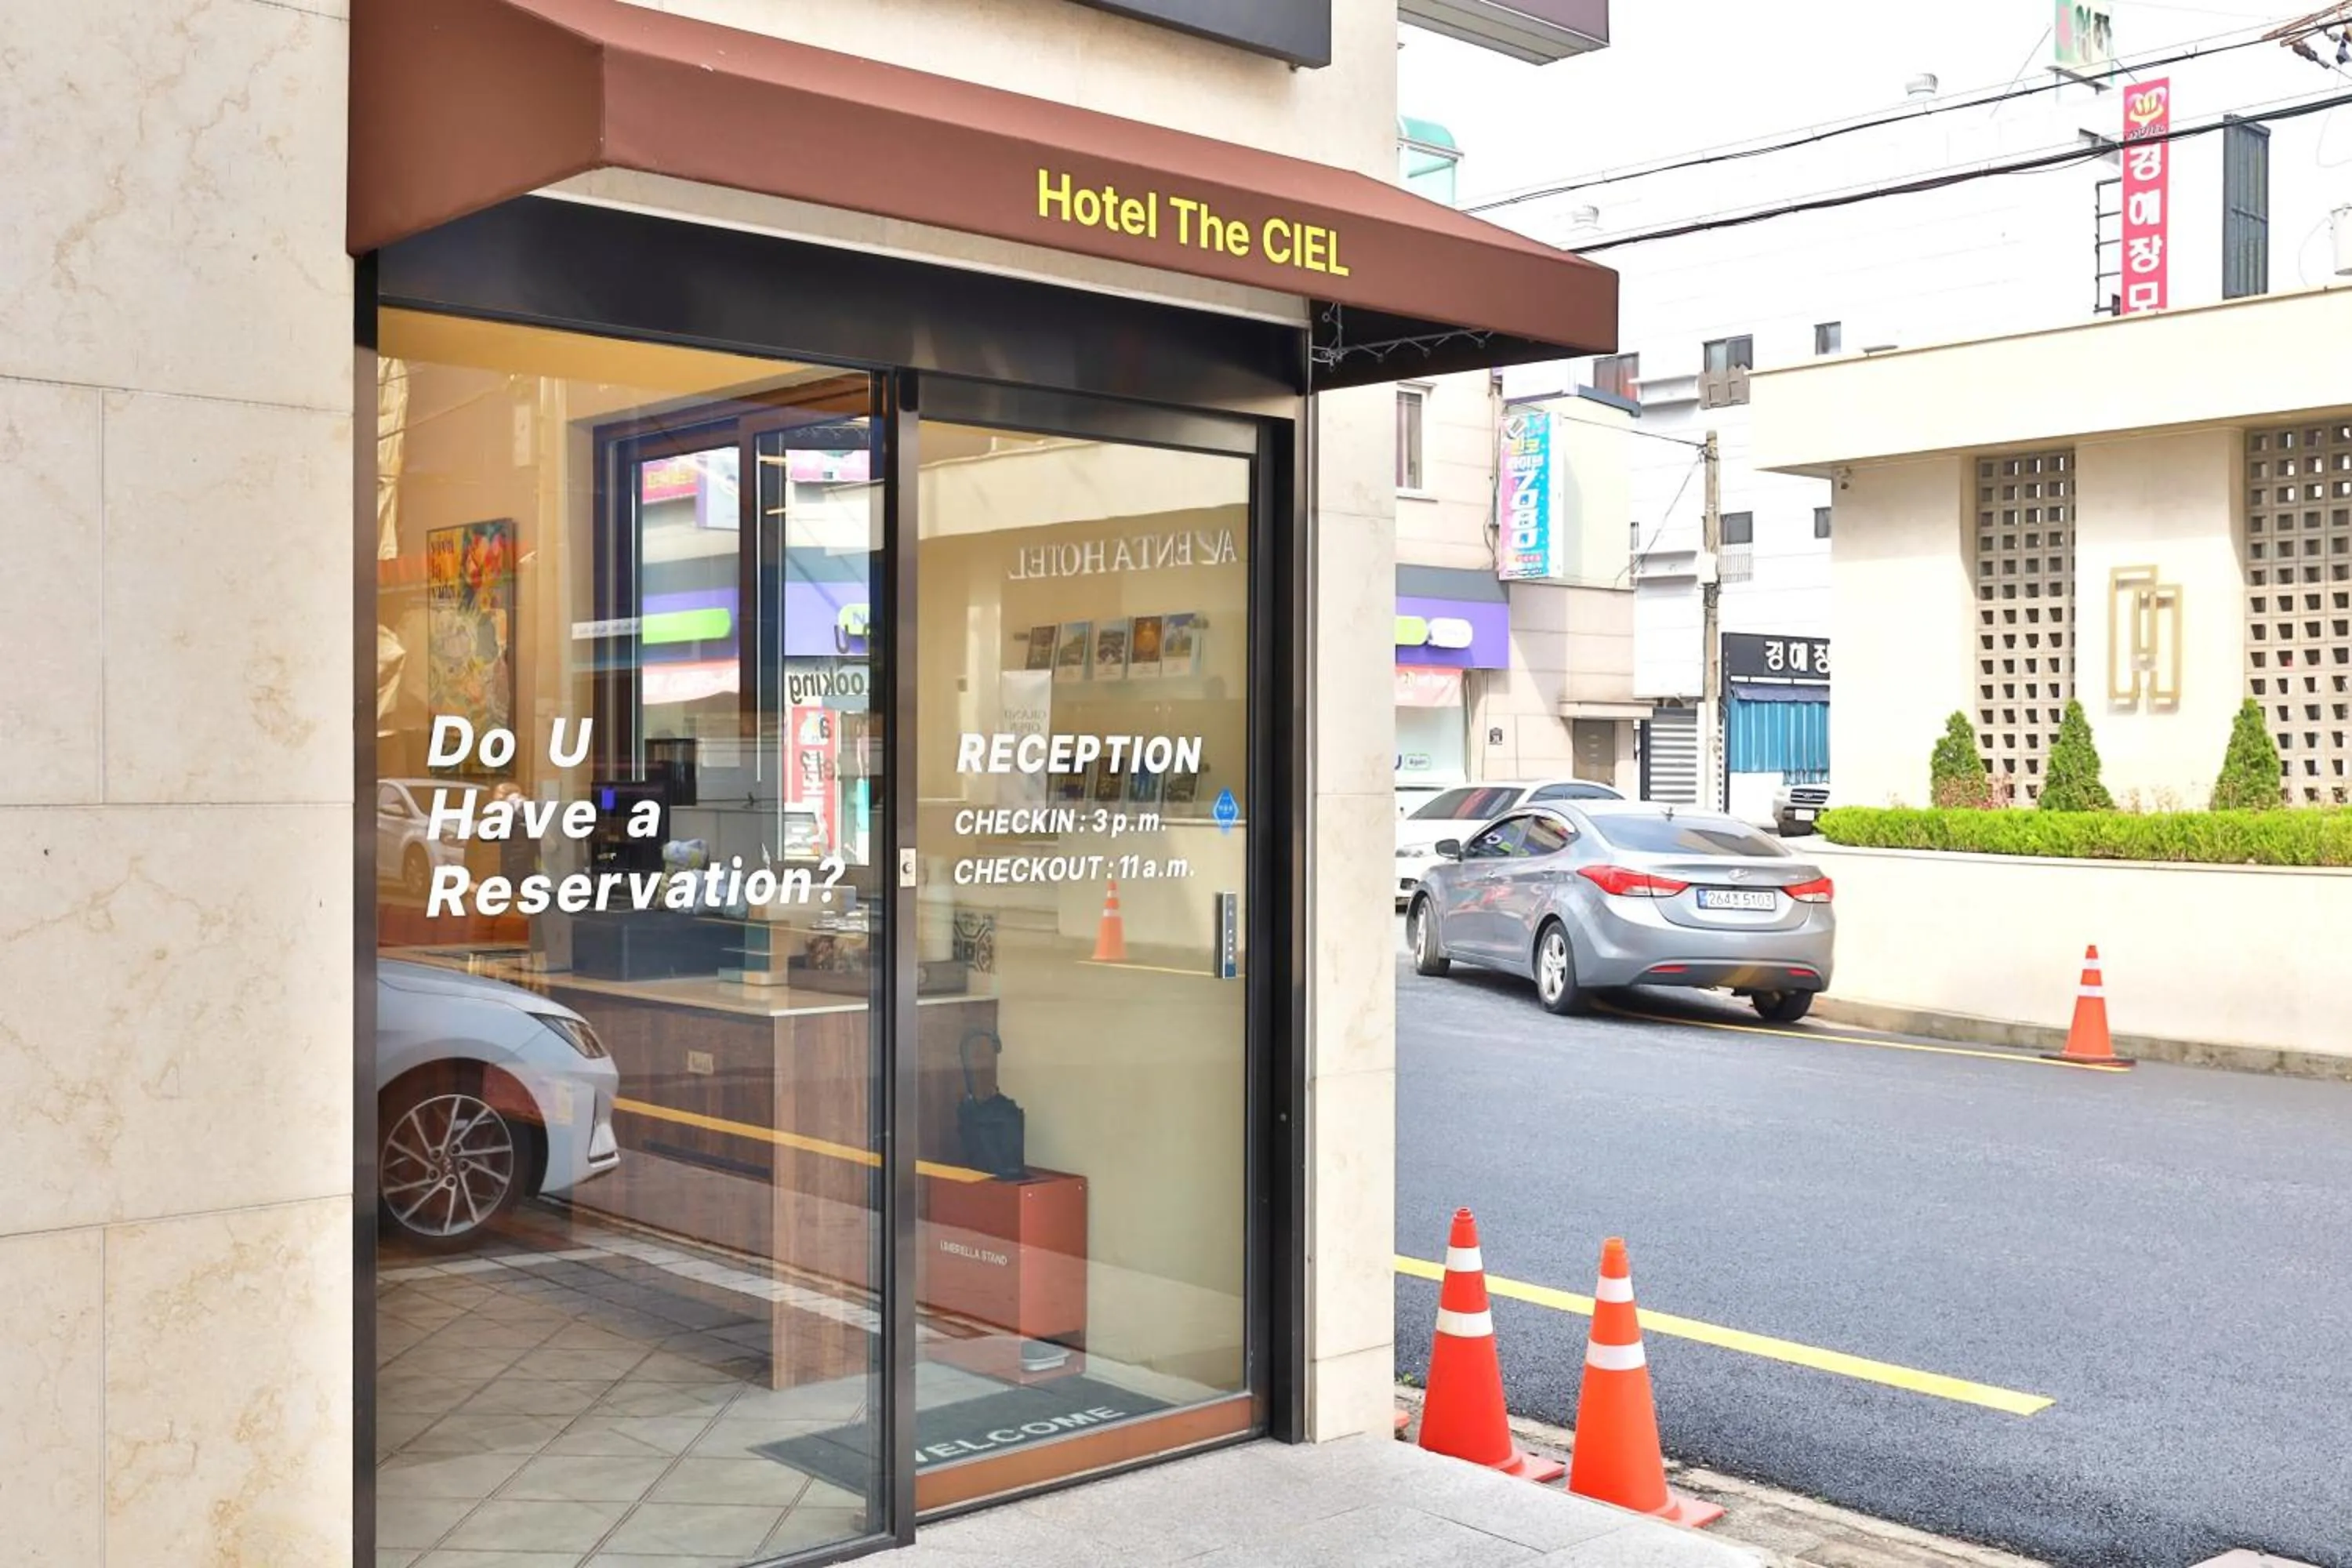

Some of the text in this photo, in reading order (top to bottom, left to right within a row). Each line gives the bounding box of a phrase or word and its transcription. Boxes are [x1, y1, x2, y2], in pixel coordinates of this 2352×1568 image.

[1037, 169, 1349, 277] Hotel The CIEL
[426, 713, 593, 768] Do U
[956, 732, 1203, 775] RECEPTION
[426, 788, 661, 842] Have a
[426, 856, 846, 918] Reservation?
[982, 1250, 1007, 1266] STAND
